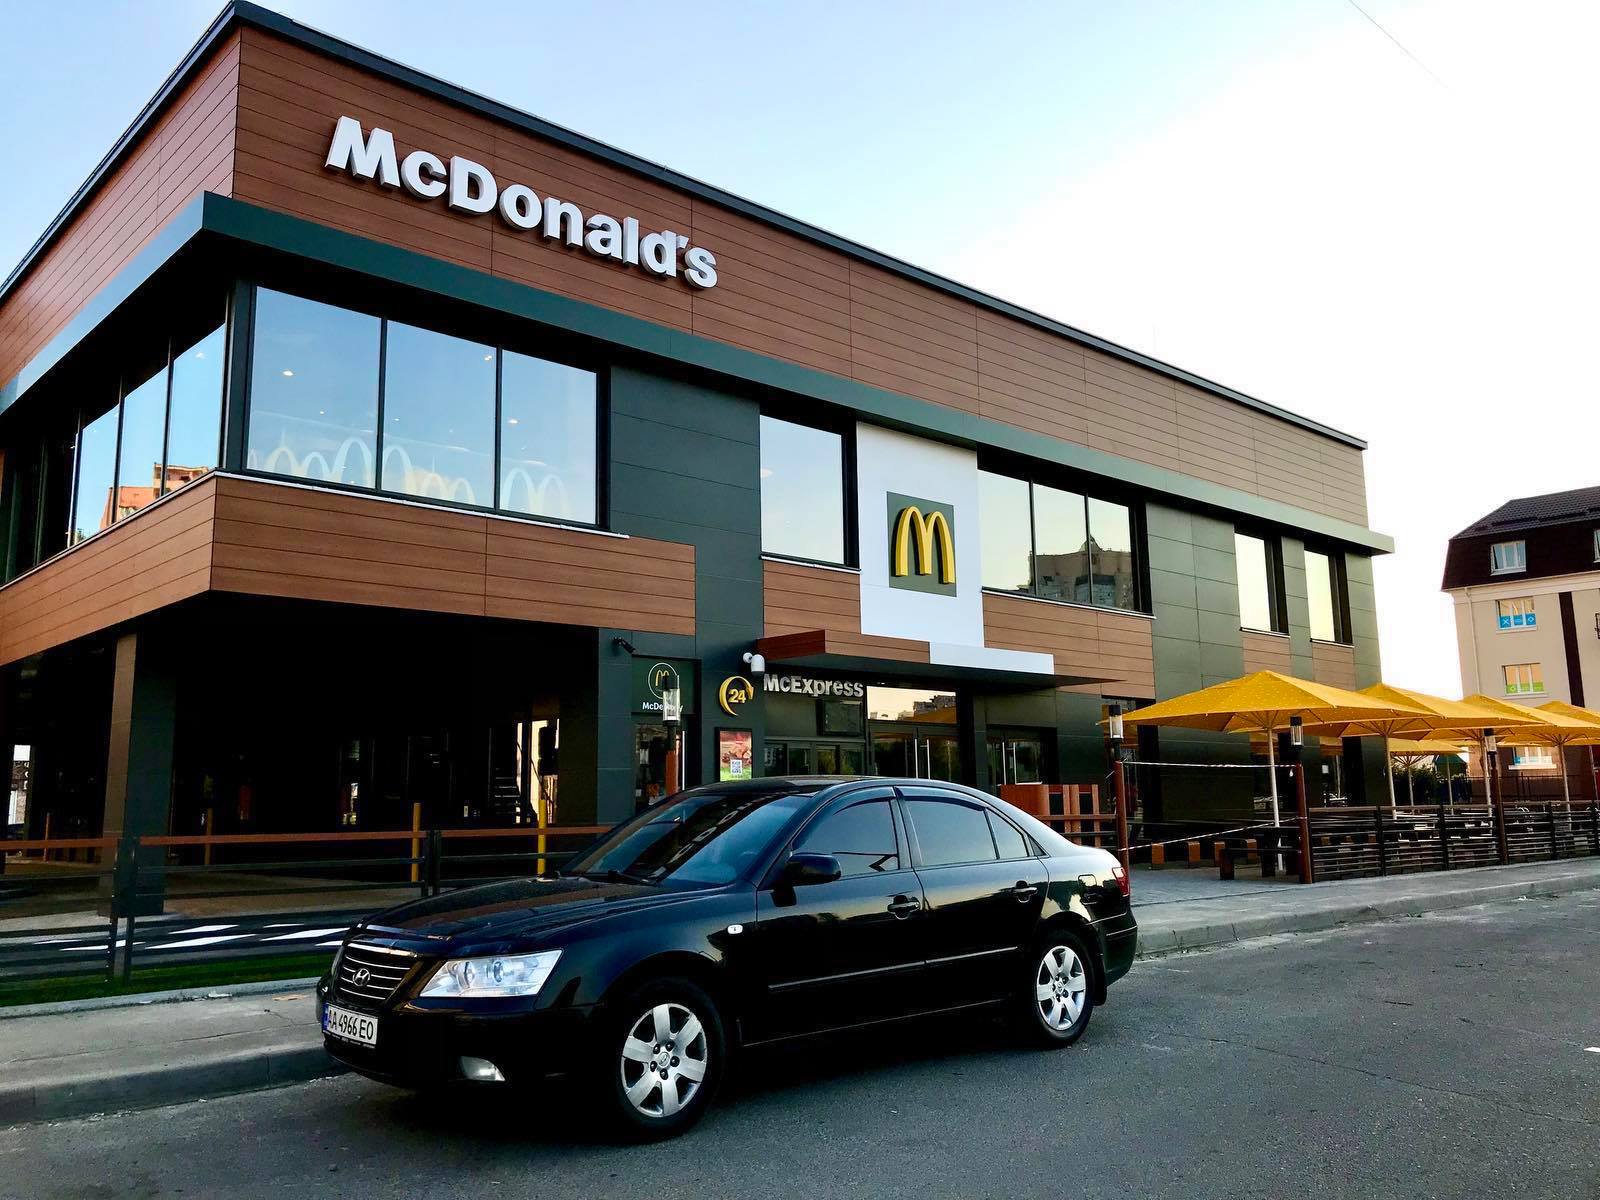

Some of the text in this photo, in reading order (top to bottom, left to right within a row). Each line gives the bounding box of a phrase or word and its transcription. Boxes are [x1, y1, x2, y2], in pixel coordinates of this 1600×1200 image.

[324, 115, 718, 289] McDonald's
[728, 688, 747, 704] 24
[763, 673, 864, 697] McExpress
[339, 1013, 358, 1037] 4966
